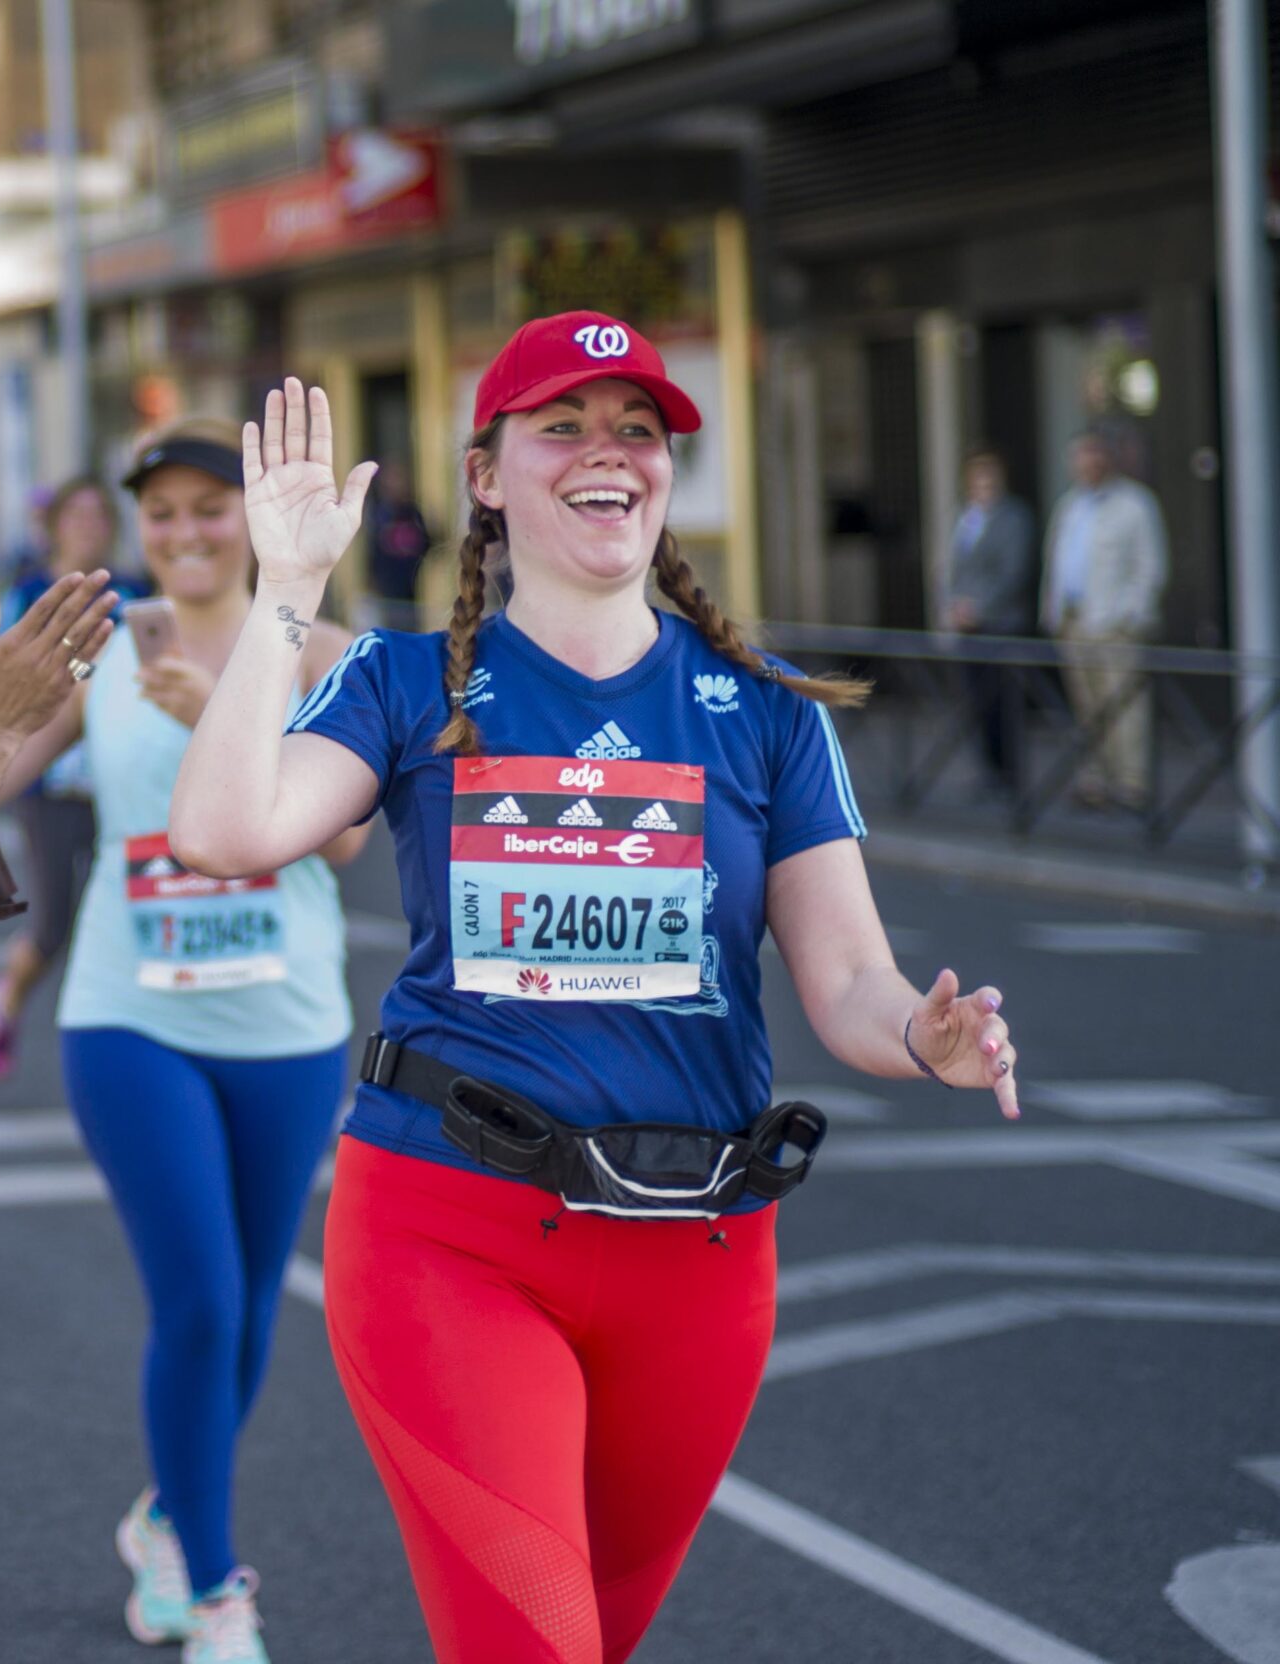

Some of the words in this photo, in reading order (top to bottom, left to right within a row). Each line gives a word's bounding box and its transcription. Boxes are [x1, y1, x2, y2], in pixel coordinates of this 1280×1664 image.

[574, 324, 629, 359] W
[575, 746, 641, 760] adidas
[558, 763, 604, 793] edp
[483, 812, 528, 824] adidas
[557, 815, 603, 827] adidas
[632, 818, 678, 832] adidas
[504, 833, 598, 859] iberCaja
[464, 880, 479, 889] 7
[662, 896, 687, 909] 2017
[460, 893, 480, 936] CAJÓN
[661, 918, 686, 929] 21K
[539, 955, 572, 963] MADRID
[560, 976, 641, 991] HUAWEI
